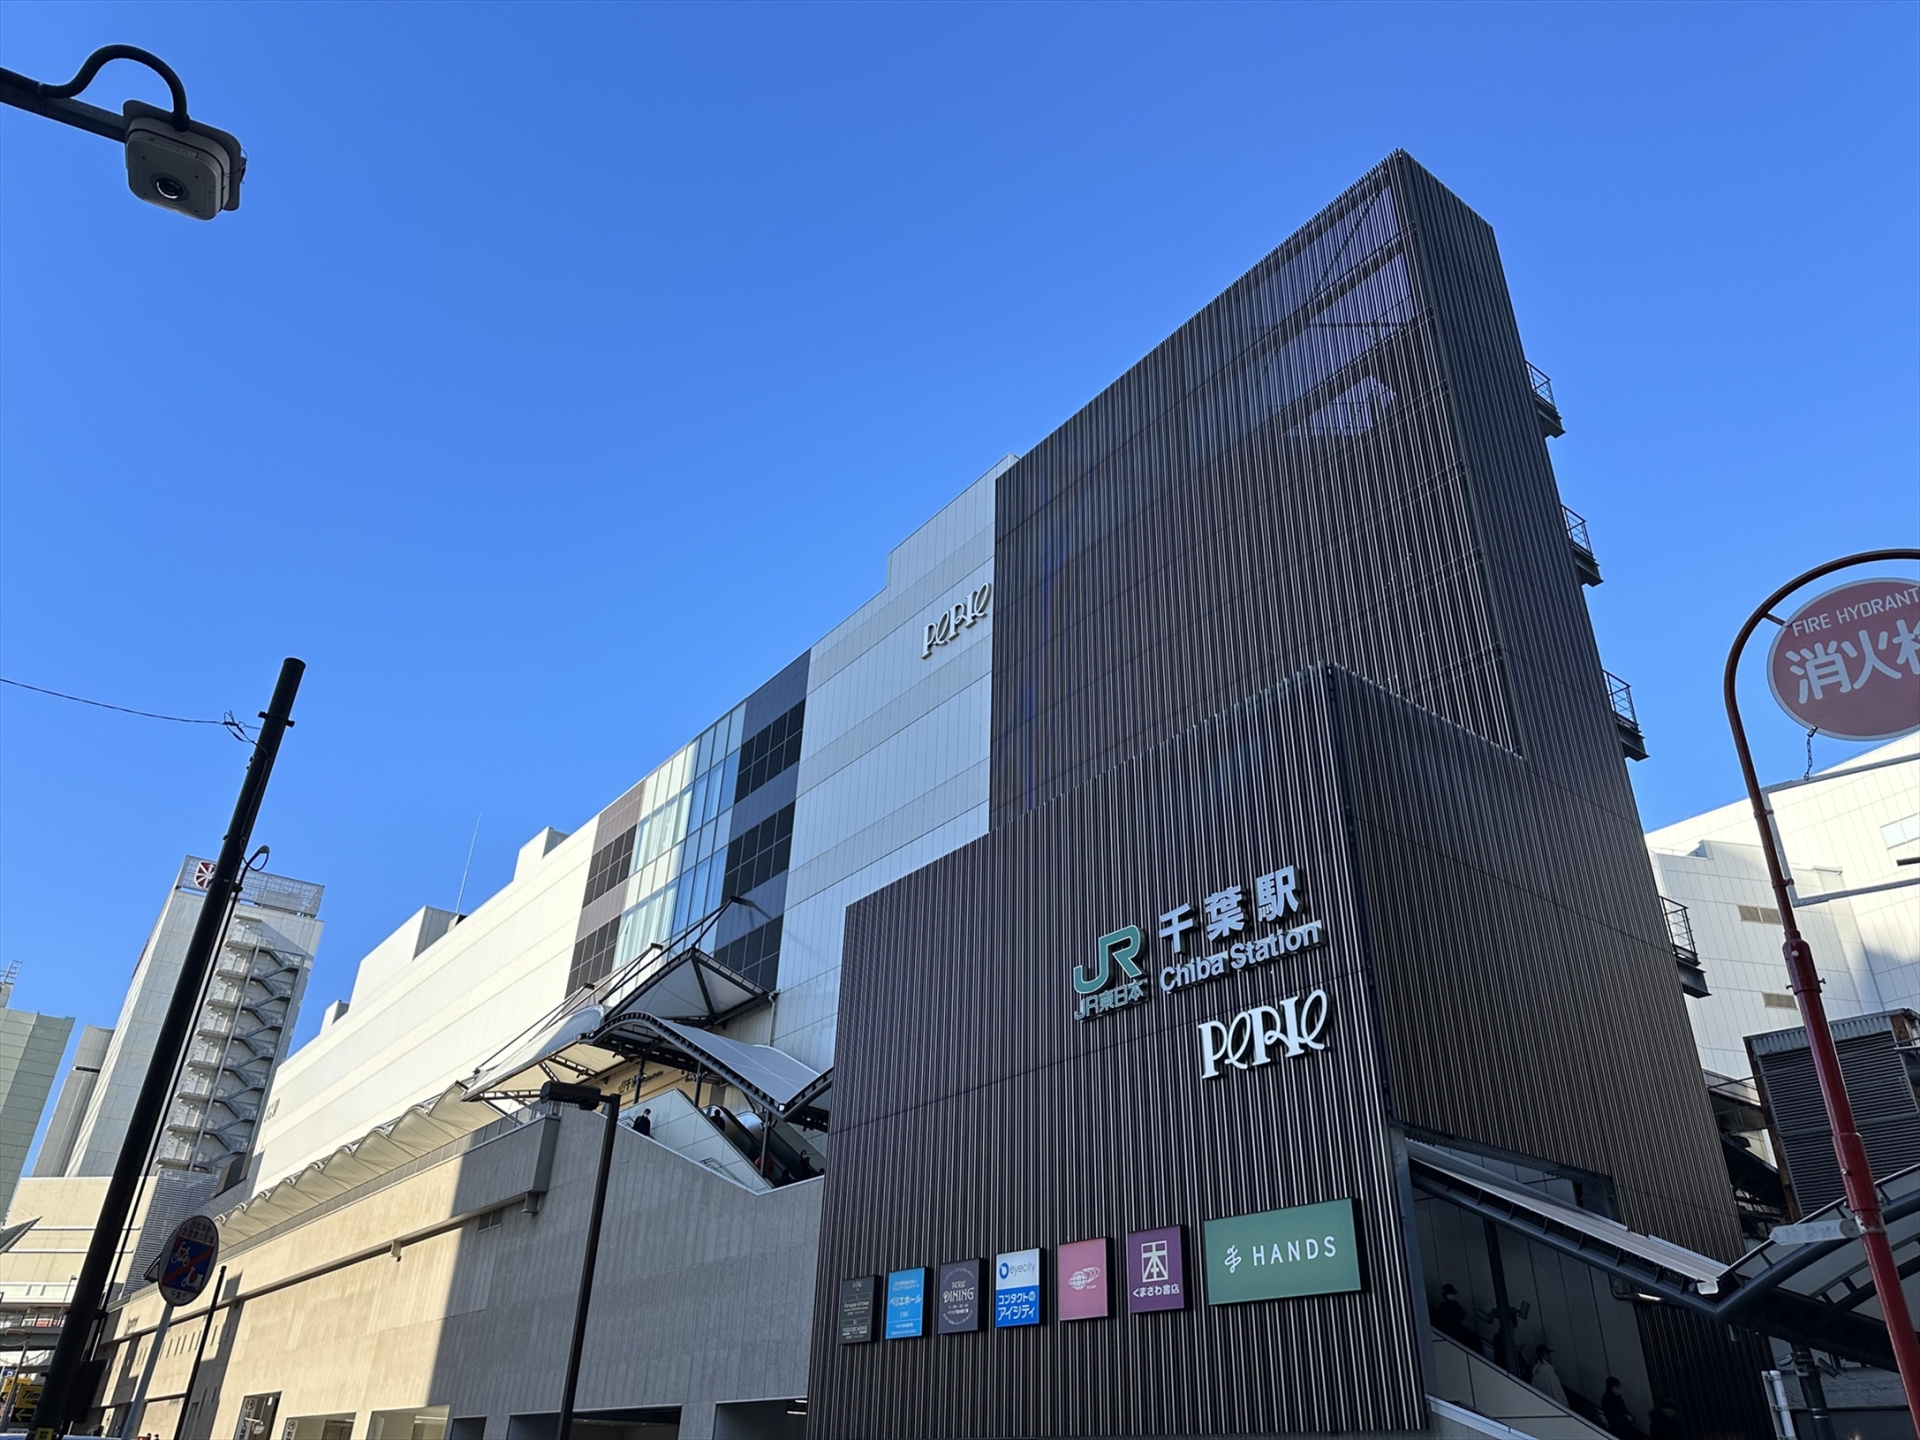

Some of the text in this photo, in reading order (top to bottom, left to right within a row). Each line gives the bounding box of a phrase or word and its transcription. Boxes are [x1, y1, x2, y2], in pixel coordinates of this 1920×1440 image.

[1792, 587, 1920, 637] FIRE HYDRANT
[1159, 865, 1299, 954] 千葉駅
[1073, 924, 1142, 994] JR
[1160, 921, 1322, 992] Chiba Station
[1074, 979, 1144, 1020] JR東日本
[1009, 1261, 1037, 1277] eyecity
[1252, 1235, 1337, 1267] HANDS
[942, 1287, 976, 1304] DINING
[998, 1291, 1037, 1305] コンタクトの
[998, 1304, 1036, 1321] アイシティ
